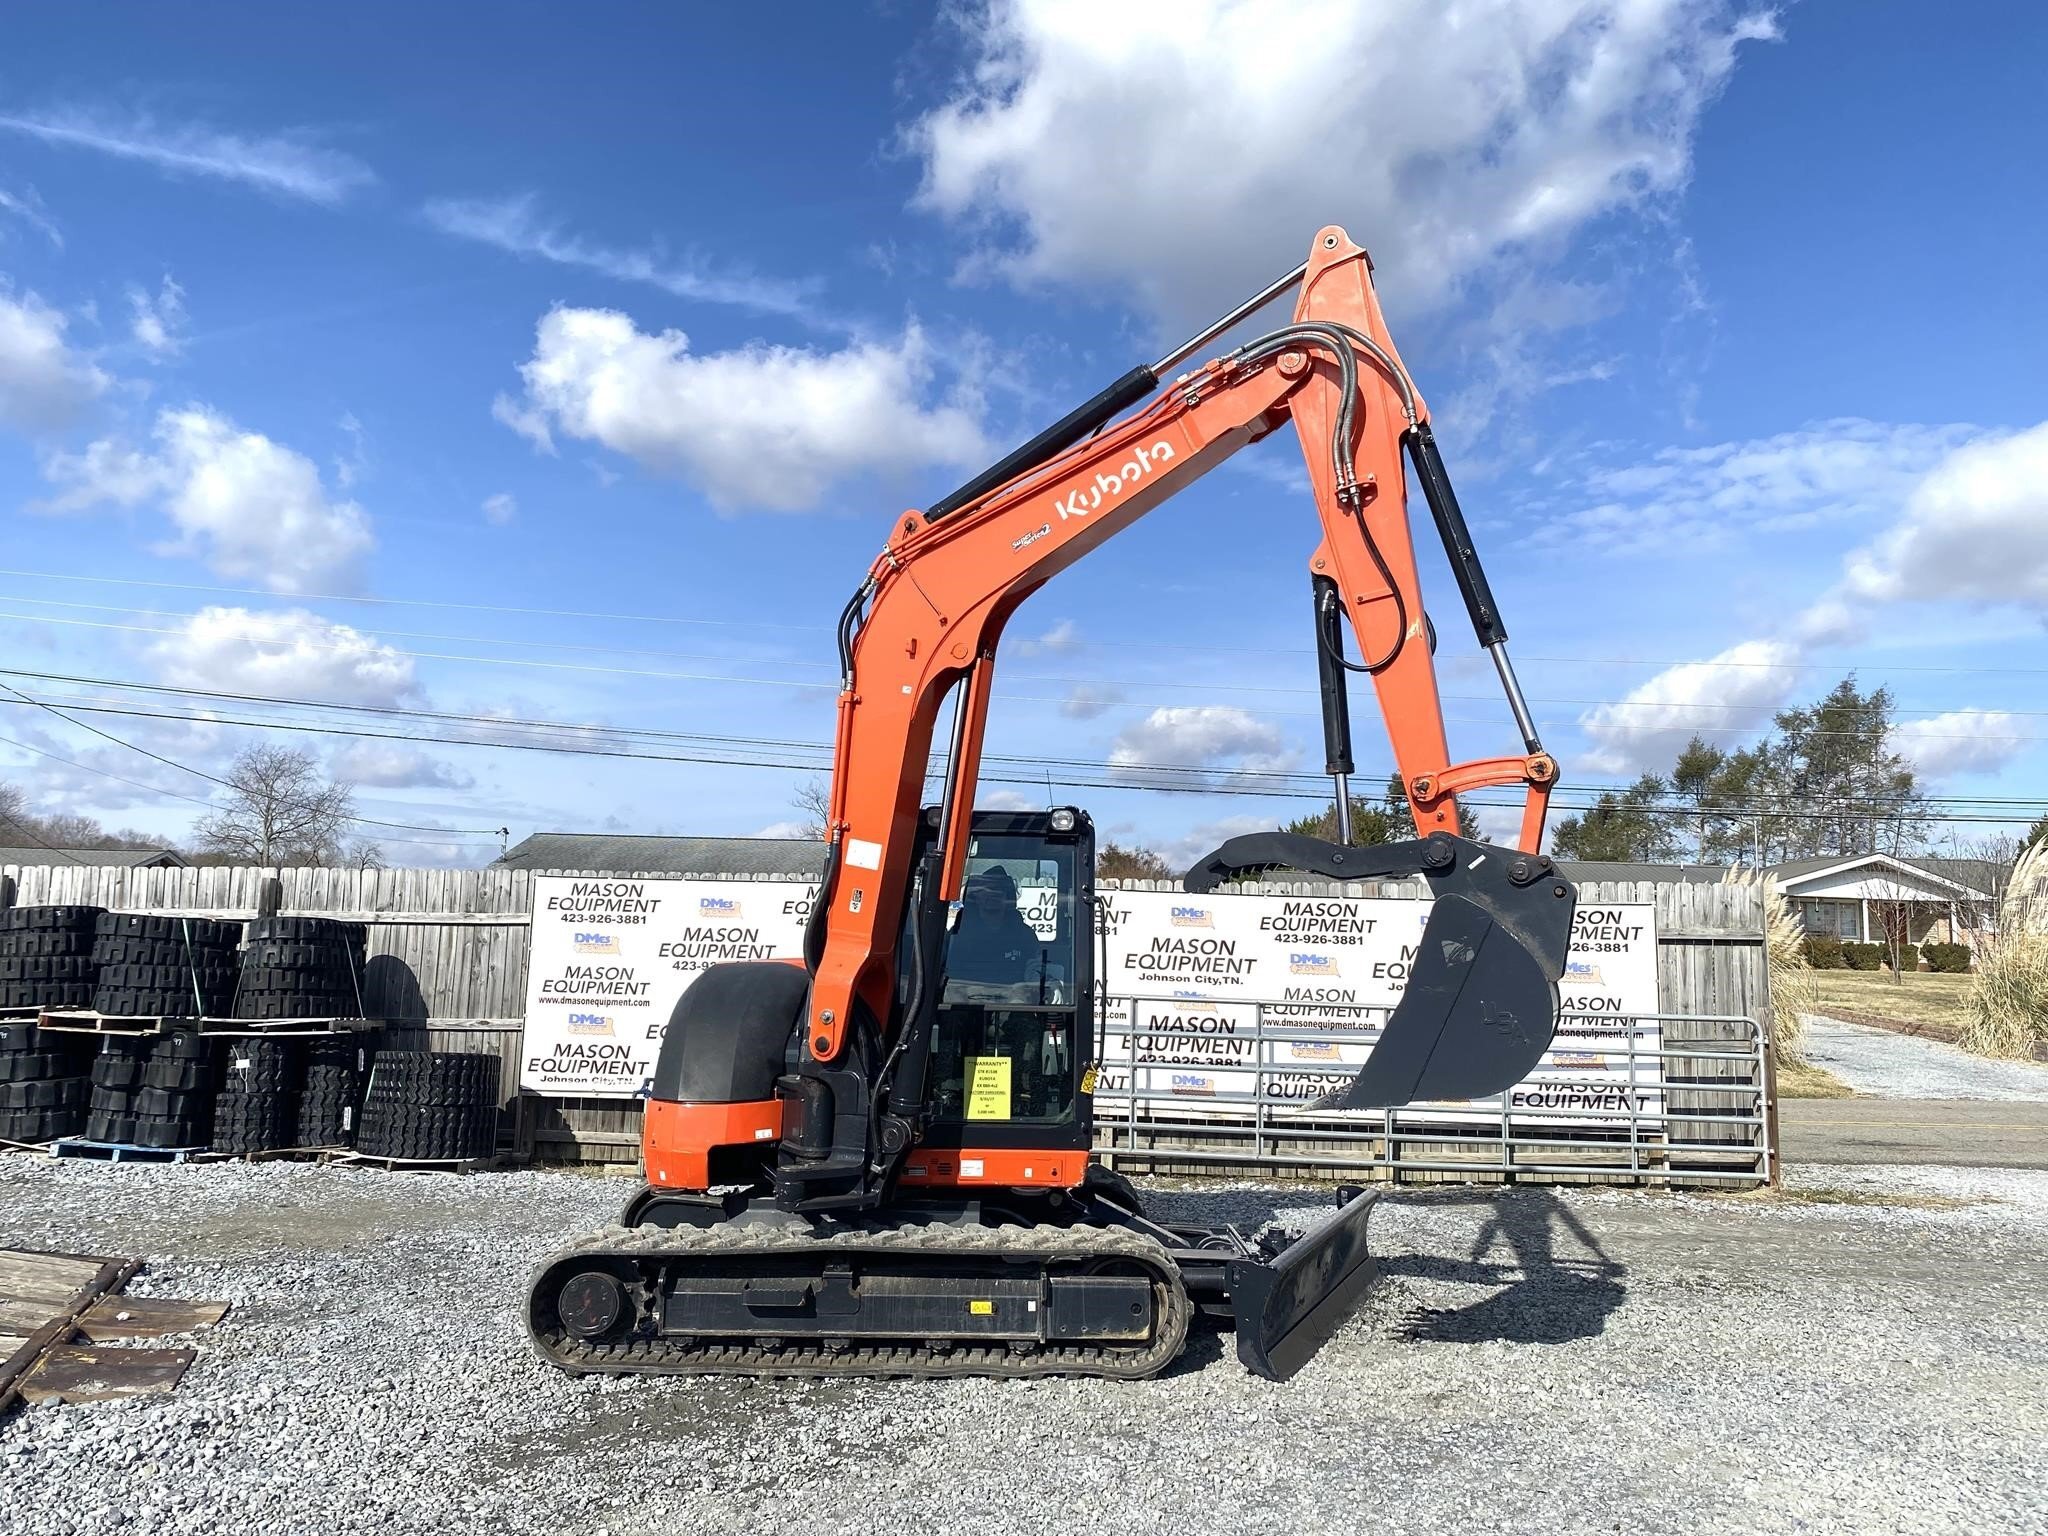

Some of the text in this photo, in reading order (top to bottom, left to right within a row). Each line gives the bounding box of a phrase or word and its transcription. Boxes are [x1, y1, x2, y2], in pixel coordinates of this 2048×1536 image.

[1054, 441, 1176, 520] Kubota
[571, 882, 644, 897] MASON
[547, 897, 661, 912] EQUIPMENT
[1283, 902, 1358, 917] MASON
[560, 913, 647, 924] 423-926-3881
[1260, 917, 1377, 933] EQUIPMENT
[1575, 910, 1623, 925] SON
[683, 927, 759, 942] MASON
[1274, 934, 1364, 945] 423-926-3881
[1571, 926, 1644, 940] PMENT
[658, 943, 777, 960] EQUIPMENT
[1151, 937, 1236, 955] MASON
[1124, 953, 1258, 974] EQUIPMENT
[565, 966, 634, 981] MASON
[1139, 973, 1244, 986] Johnson City,TN.
[542, 979, 651, 995] EQUIPMENT
[538, 996, 651, 1008] www.dmasonequipment.com
[1284, 987, 1356, 1003] MASON
[1262, 1004, 1372, 1018] EQUIPMENT
[1561, 997, 1622, 1011] ASON
[1148, 1014, 1237, 1034] MASON
[553, 1043, 631, 1059] MASON
[527, 1058, 650, 1075] EQUIPMENT
[540, 1075, 588, 1083] Johnson
[1512, 1092, 1650, 1111] EQUIPMENT
